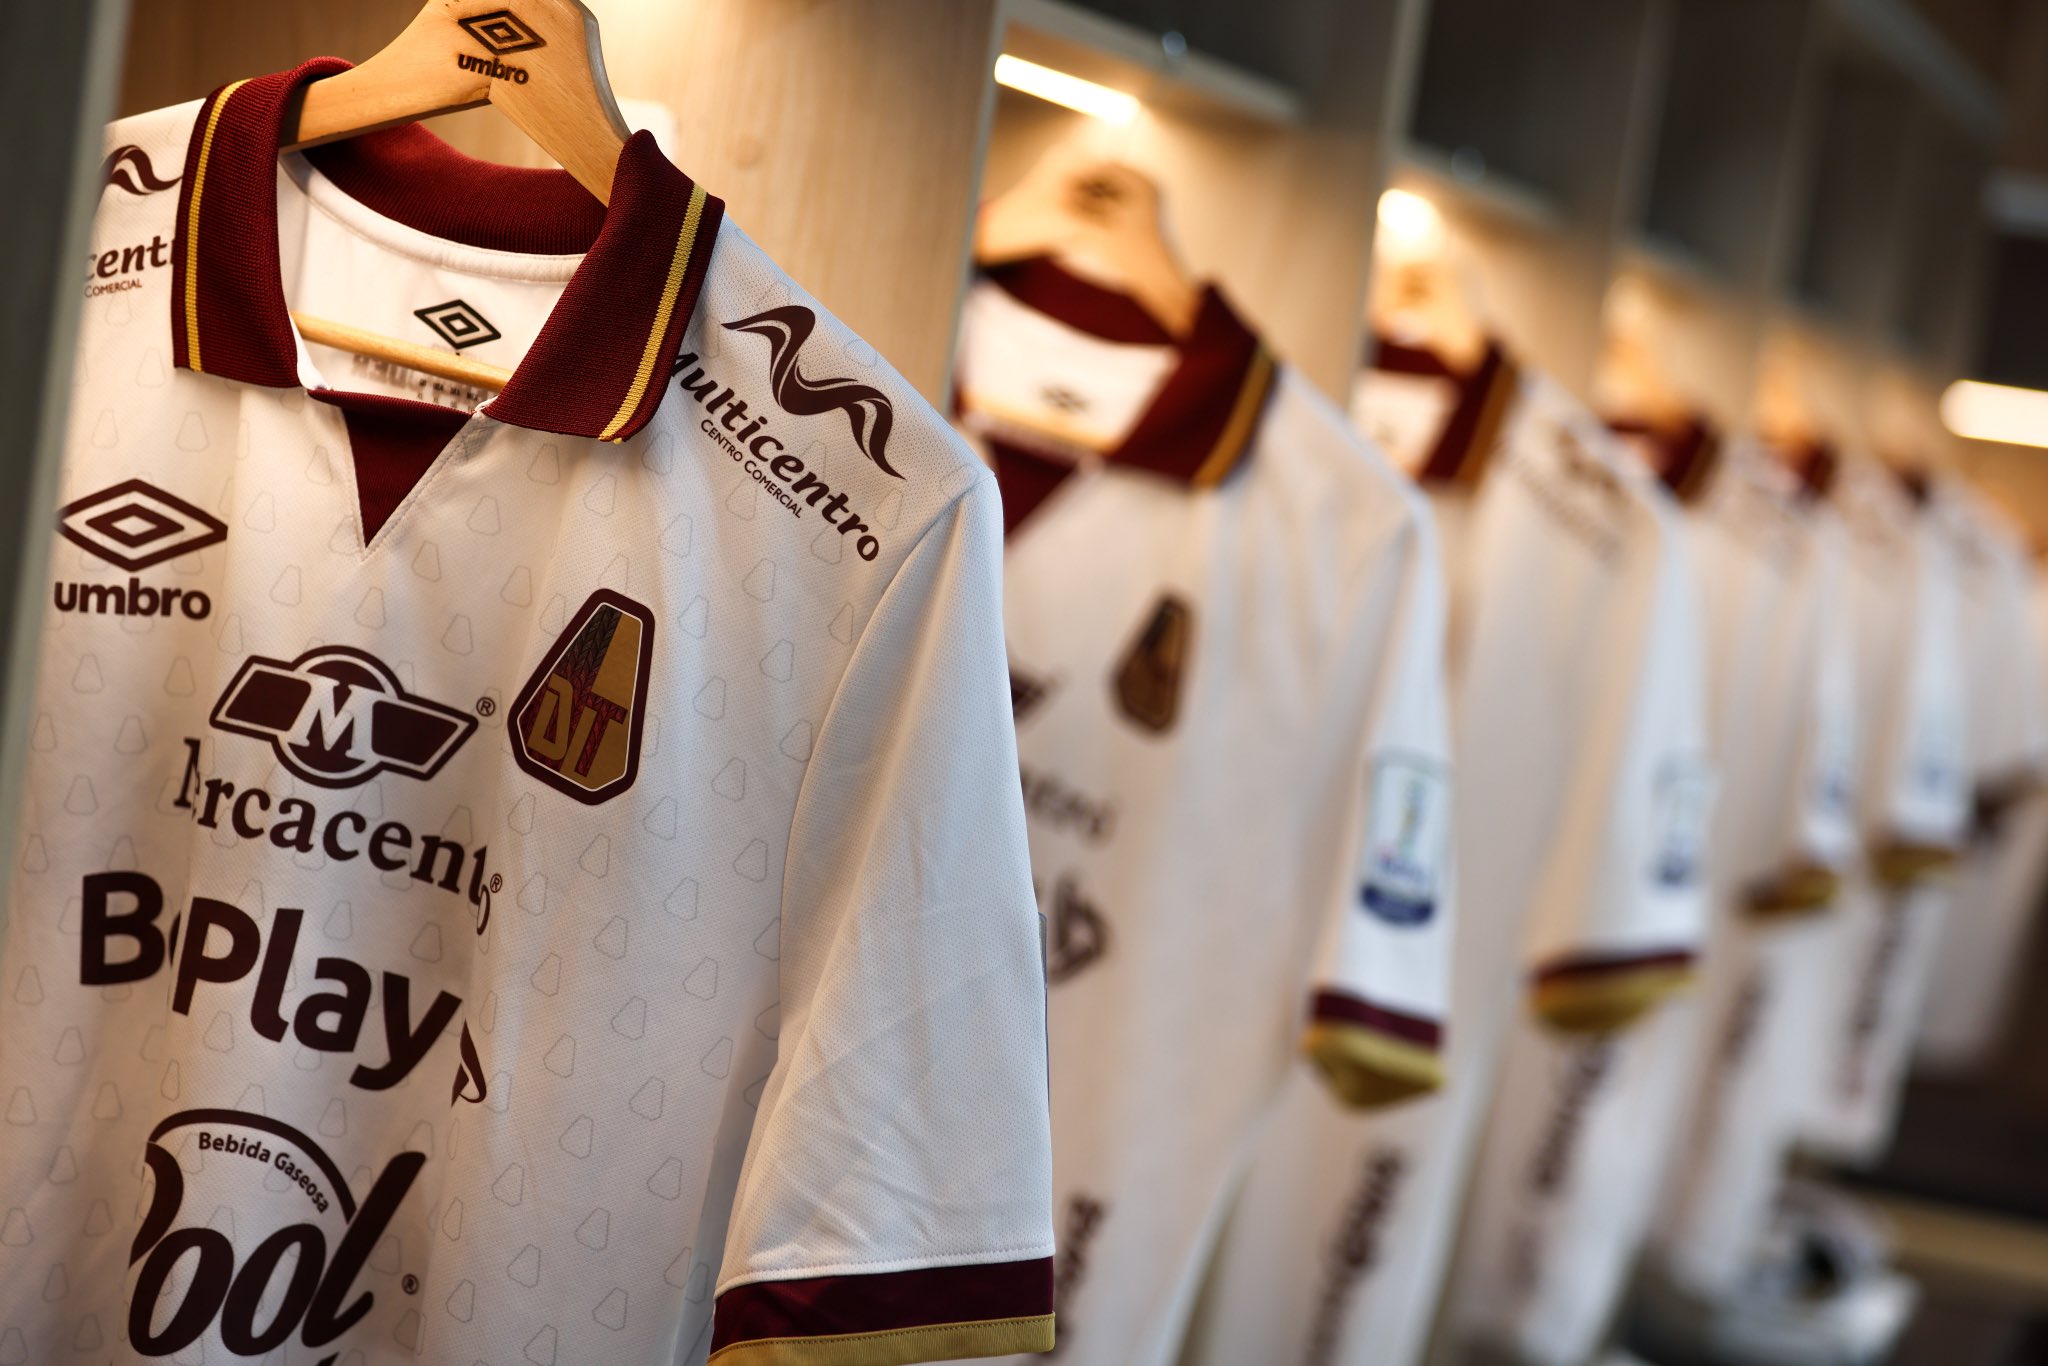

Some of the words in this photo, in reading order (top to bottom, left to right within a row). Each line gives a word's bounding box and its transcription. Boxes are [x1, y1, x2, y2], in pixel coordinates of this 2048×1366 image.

[457, 54, 529, 85] umbro
[84, 279, 142, 298] COMERCIAL
[701, 419, 743, 462] CENTRO
[744, 460, 802, 519] COMERCIAL
[54, 577, 211, 621] umbro
[80, 871, 463, 1091] BPlay
[199, 1132, 271, 1163] Bebida
[274, 1152, 329, 1214] Gaseosa
